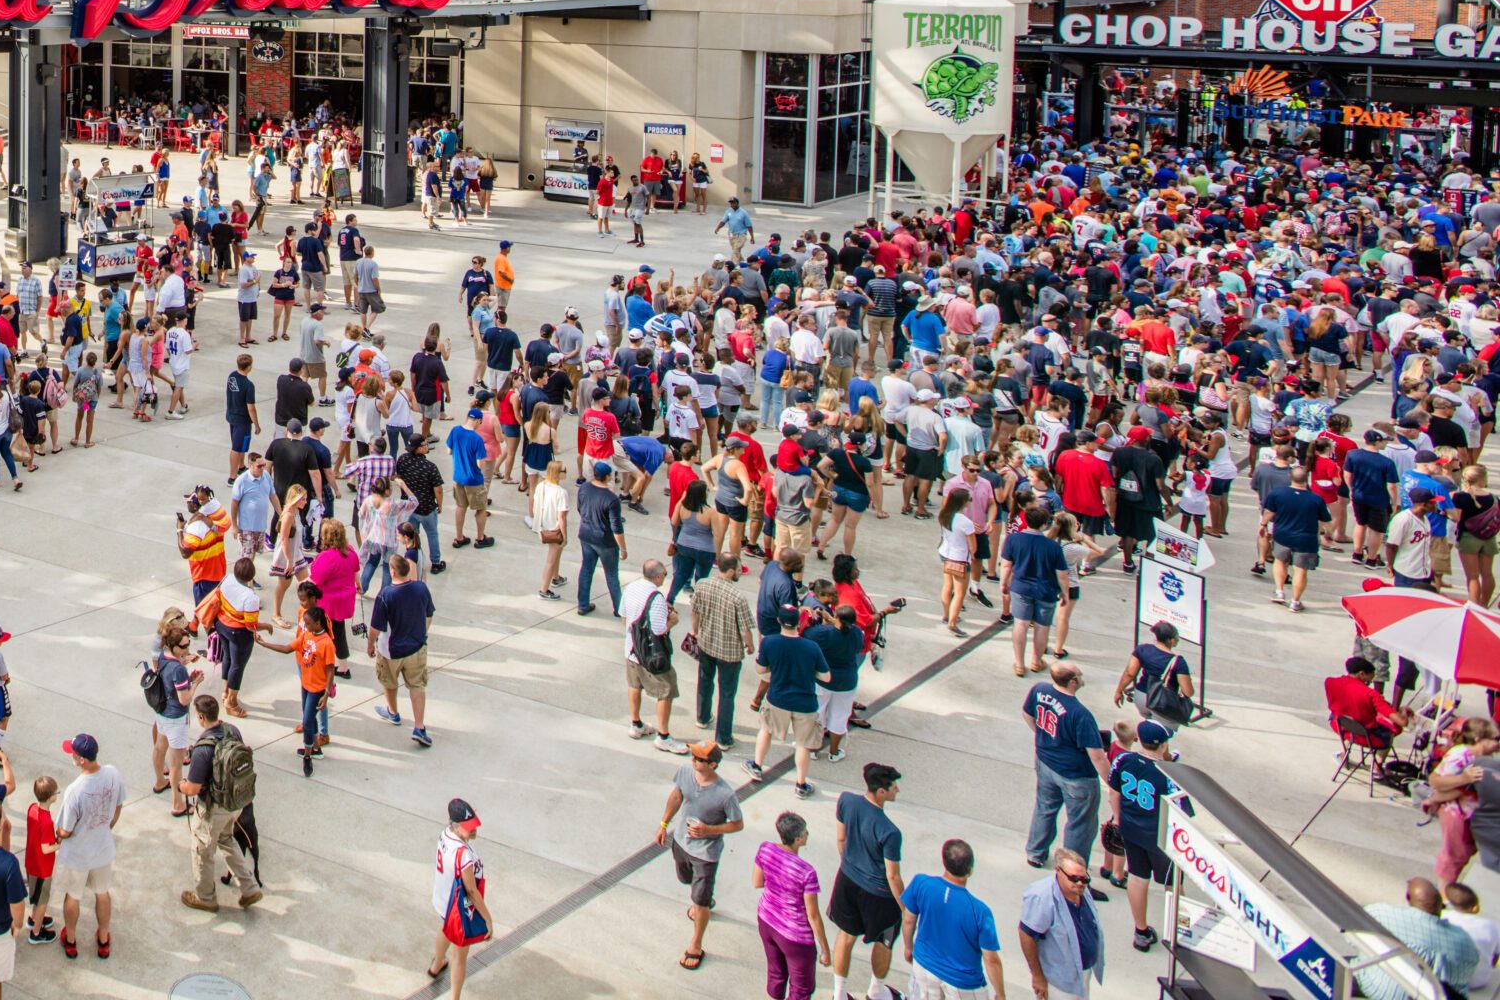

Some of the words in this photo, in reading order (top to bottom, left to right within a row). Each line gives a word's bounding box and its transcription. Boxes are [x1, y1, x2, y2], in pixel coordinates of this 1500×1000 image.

[197, 26, 211, 36] FOX
[903, 12, 1002, 52] TERRAPIN
[1059, 13, 1203, 48] CHOP
[1221, 17, 1415, 55] HOUSE
[647, 126, 683, 136] PROGRAMS
[545, 176, 571, 189] Coors
[95, 255, 125, 270] Coors
[169, 340, 178, 355] 44
[675, 415, 681, 428] 5
[1034, 692, 1065, 717] McCANN
[1034, 704, 1057, 738] 16
[1120, 770, 1154, 810] 26
[1171, 825, 1226, 893] Coors
[1228, 881, 1285, 946] LIGHT
